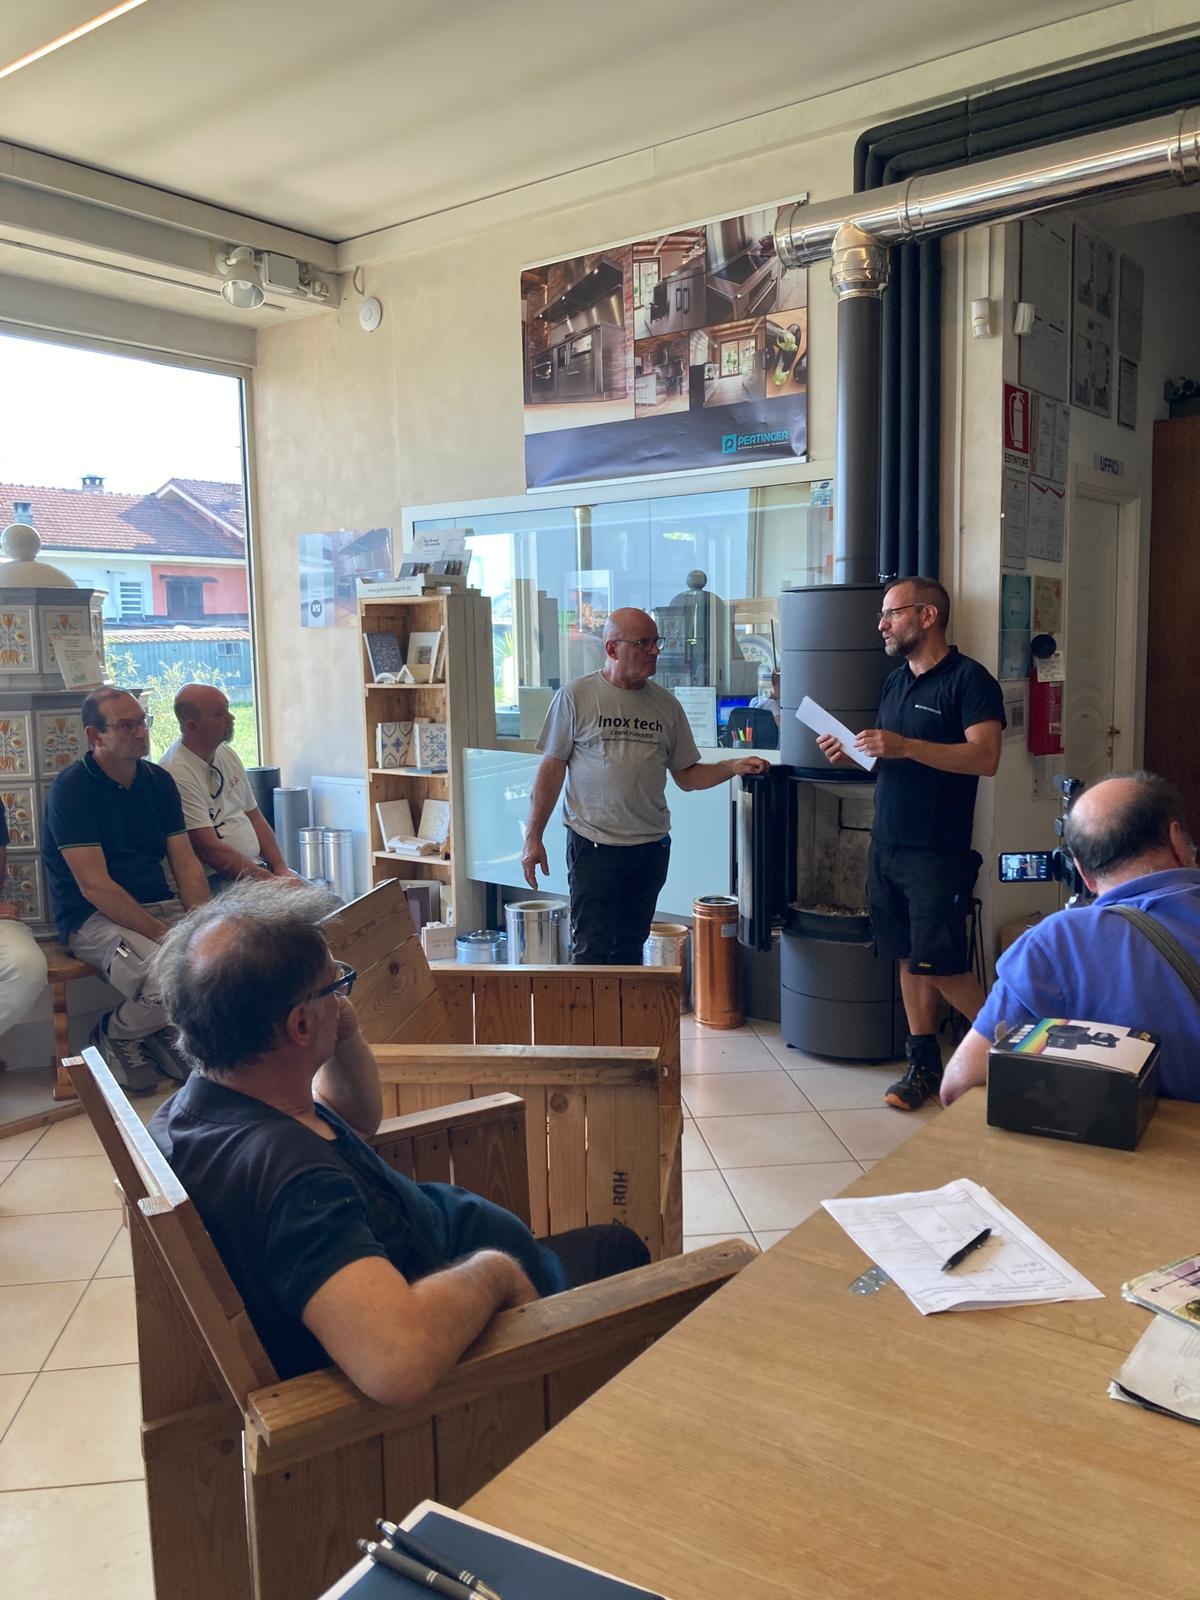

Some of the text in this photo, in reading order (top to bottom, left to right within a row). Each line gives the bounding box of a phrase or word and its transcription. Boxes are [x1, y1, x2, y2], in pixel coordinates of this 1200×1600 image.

[738, 431, 789, 445] PERTINGER
[1004, 453, 1029, 469] ESTINTORE
[598, 715, 663, 733] Inox tech
[613, 1172, 628, 1205] ROH
